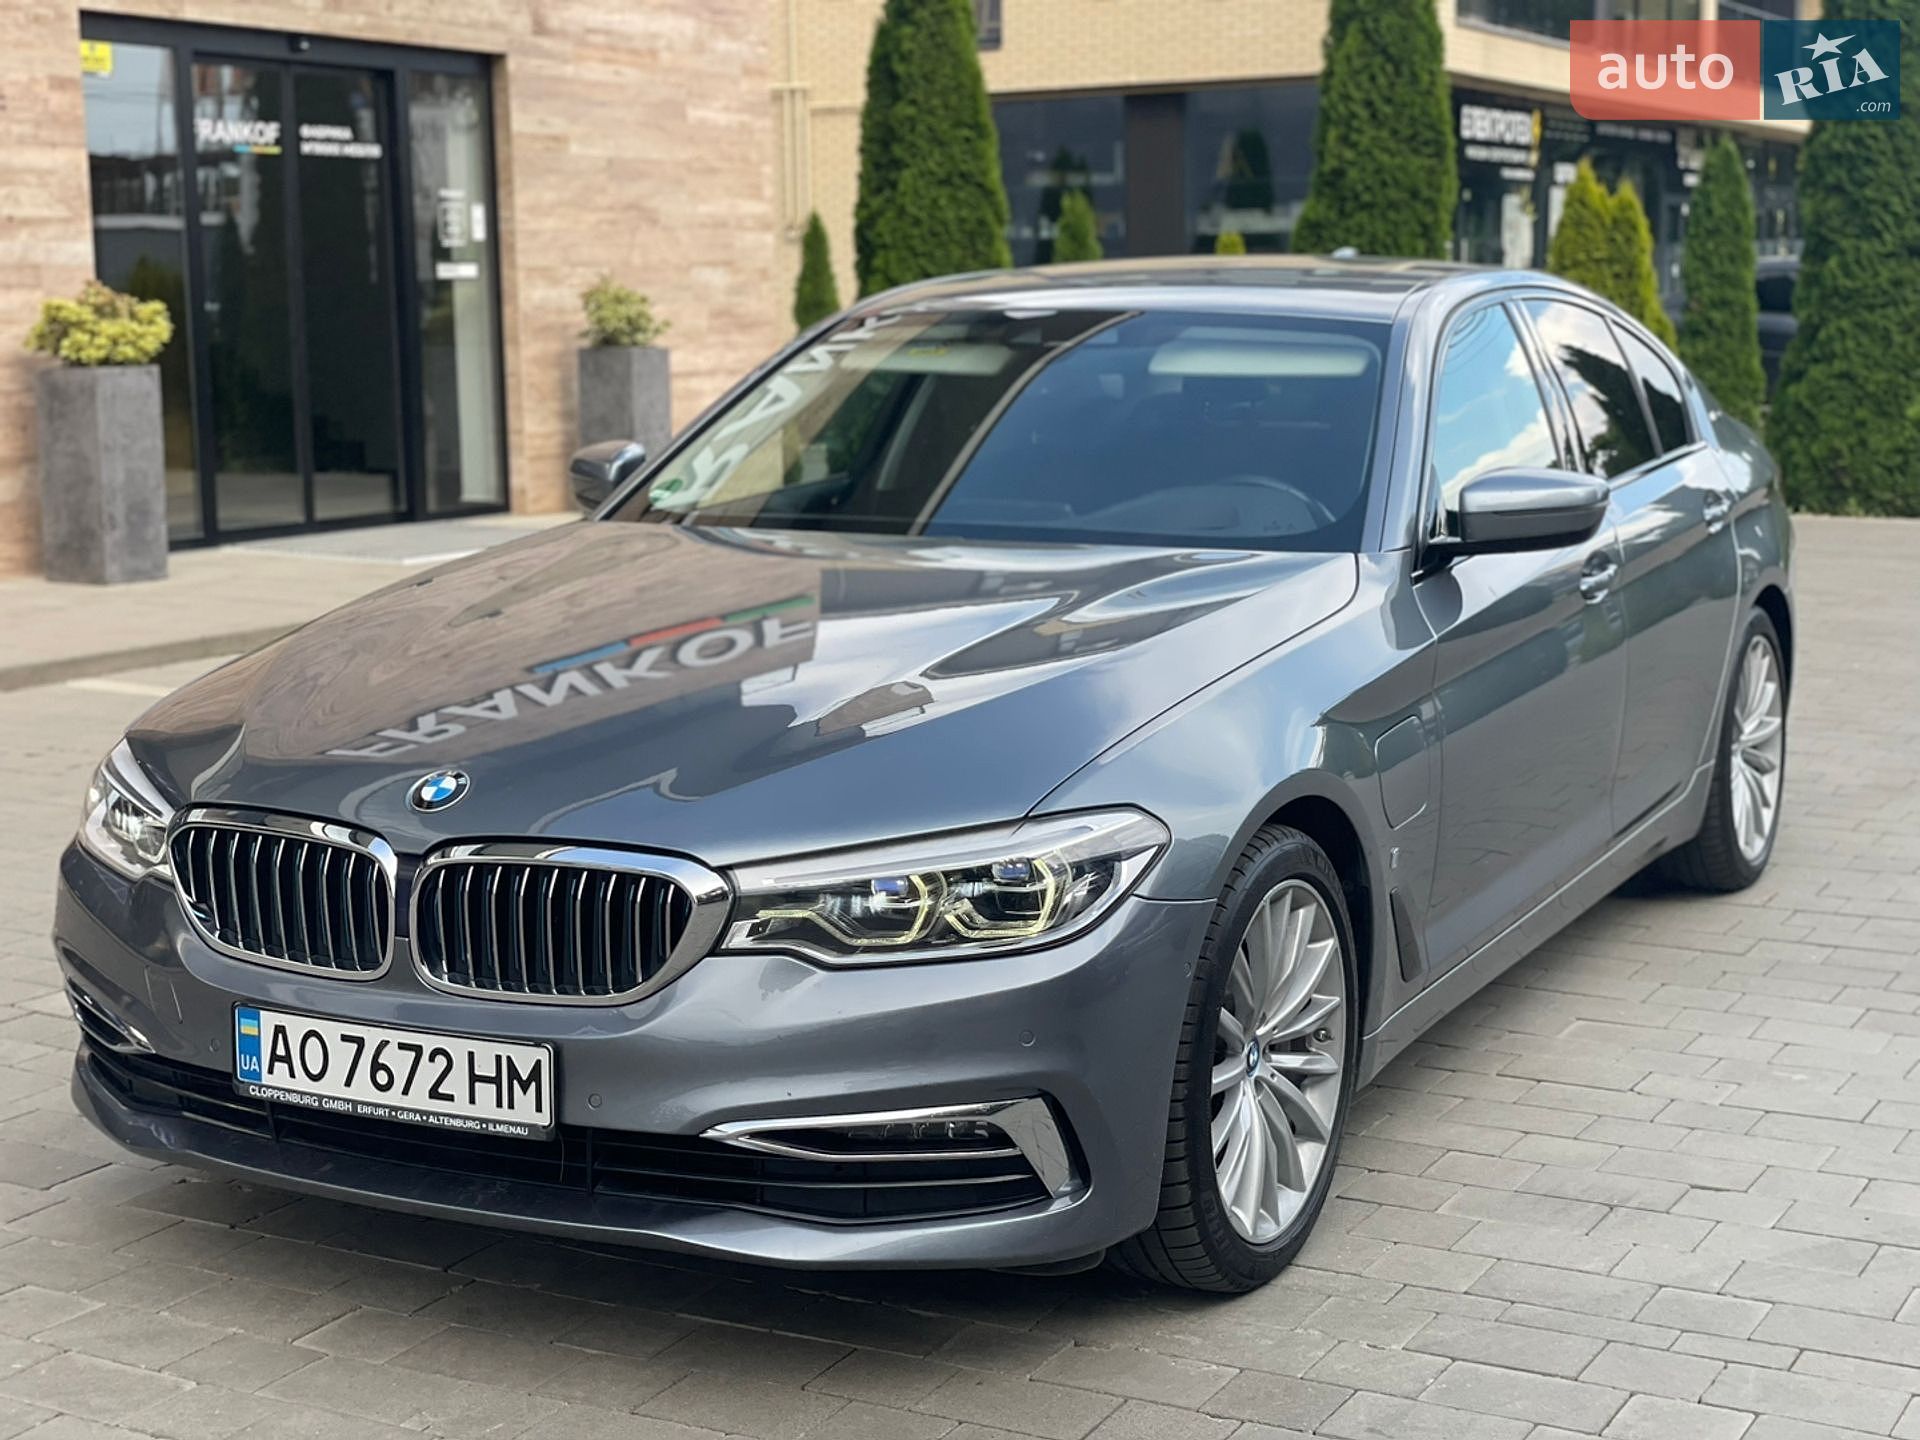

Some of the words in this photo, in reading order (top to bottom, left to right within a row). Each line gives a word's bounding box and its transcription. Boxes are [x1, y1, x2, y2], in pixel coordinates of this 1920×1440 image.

[241, 1054, 260, 1072] UA
[267, 1024, 329, 1082] AO
[340, 1033, 455, 1103] 7672
[467, 1050, 543, 1113] HM
[249, 1085, 319, 1107] CLOPPENBURG
[322, 1097, 352, 1111] GMBH
[357, 1104, 390, 1118] ERFURT
[397, 1111, 422, 1122] GERA
[428, 1115, 481, 1130] ALTENBURG
[487, 1123, 529, 1136] ILMENAU
